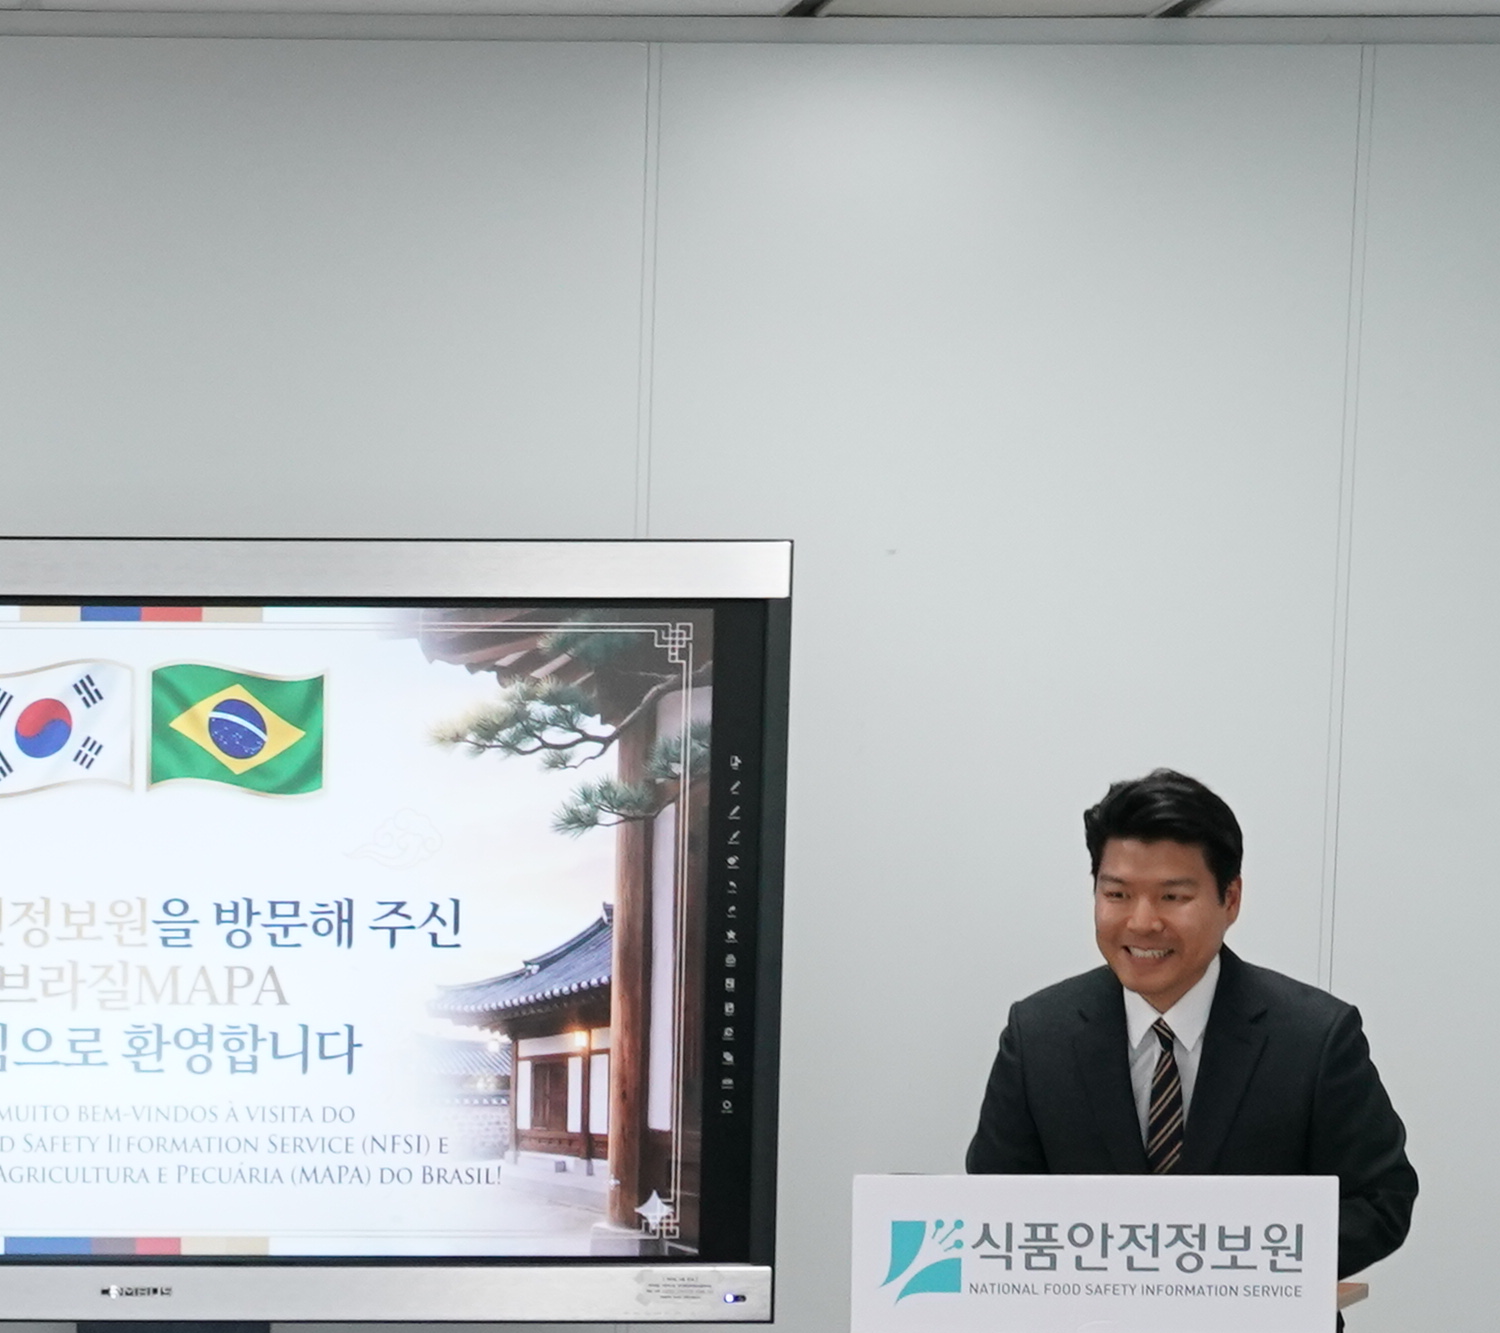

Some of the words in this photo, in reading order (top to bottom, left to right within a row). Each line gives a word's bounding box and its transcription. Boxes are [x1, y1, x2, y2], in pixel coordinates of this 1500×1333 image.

[213, 897, 354, 950] 방문해
[368, 897, 462, 949] 주신
[121, 1022, 364, 1075] 환영합니다
[245, 1105, 315, 1124] VISITA
[321, 1105, 356, 1124] DO
[22, 1132, 101, 1153] SAFETY
[267, 1133, 355, 1154] SERVICE
[362, 1134, 431, 1157] (NFSI)
[176, 1161, 285, 1185] PECUÁRIA
[291, 1165, 372, 1187] (MAPA)
[379, 1167, 414, 1185] DO
[421, 1165, 502, 1186] BRASIL!
[970, 1221, 1305, 1275] 식품안전정보원
[968, 1282, 1039, 1296] NATIONAL
[1044, 1283, 1082, 1296] FOOD
[1085, 1283, 1138, 1297] SAFETY
[1141, 1284, 1239, 1297] INFORMATION
[1243, 1284, 1303, 1298] SERVICE
